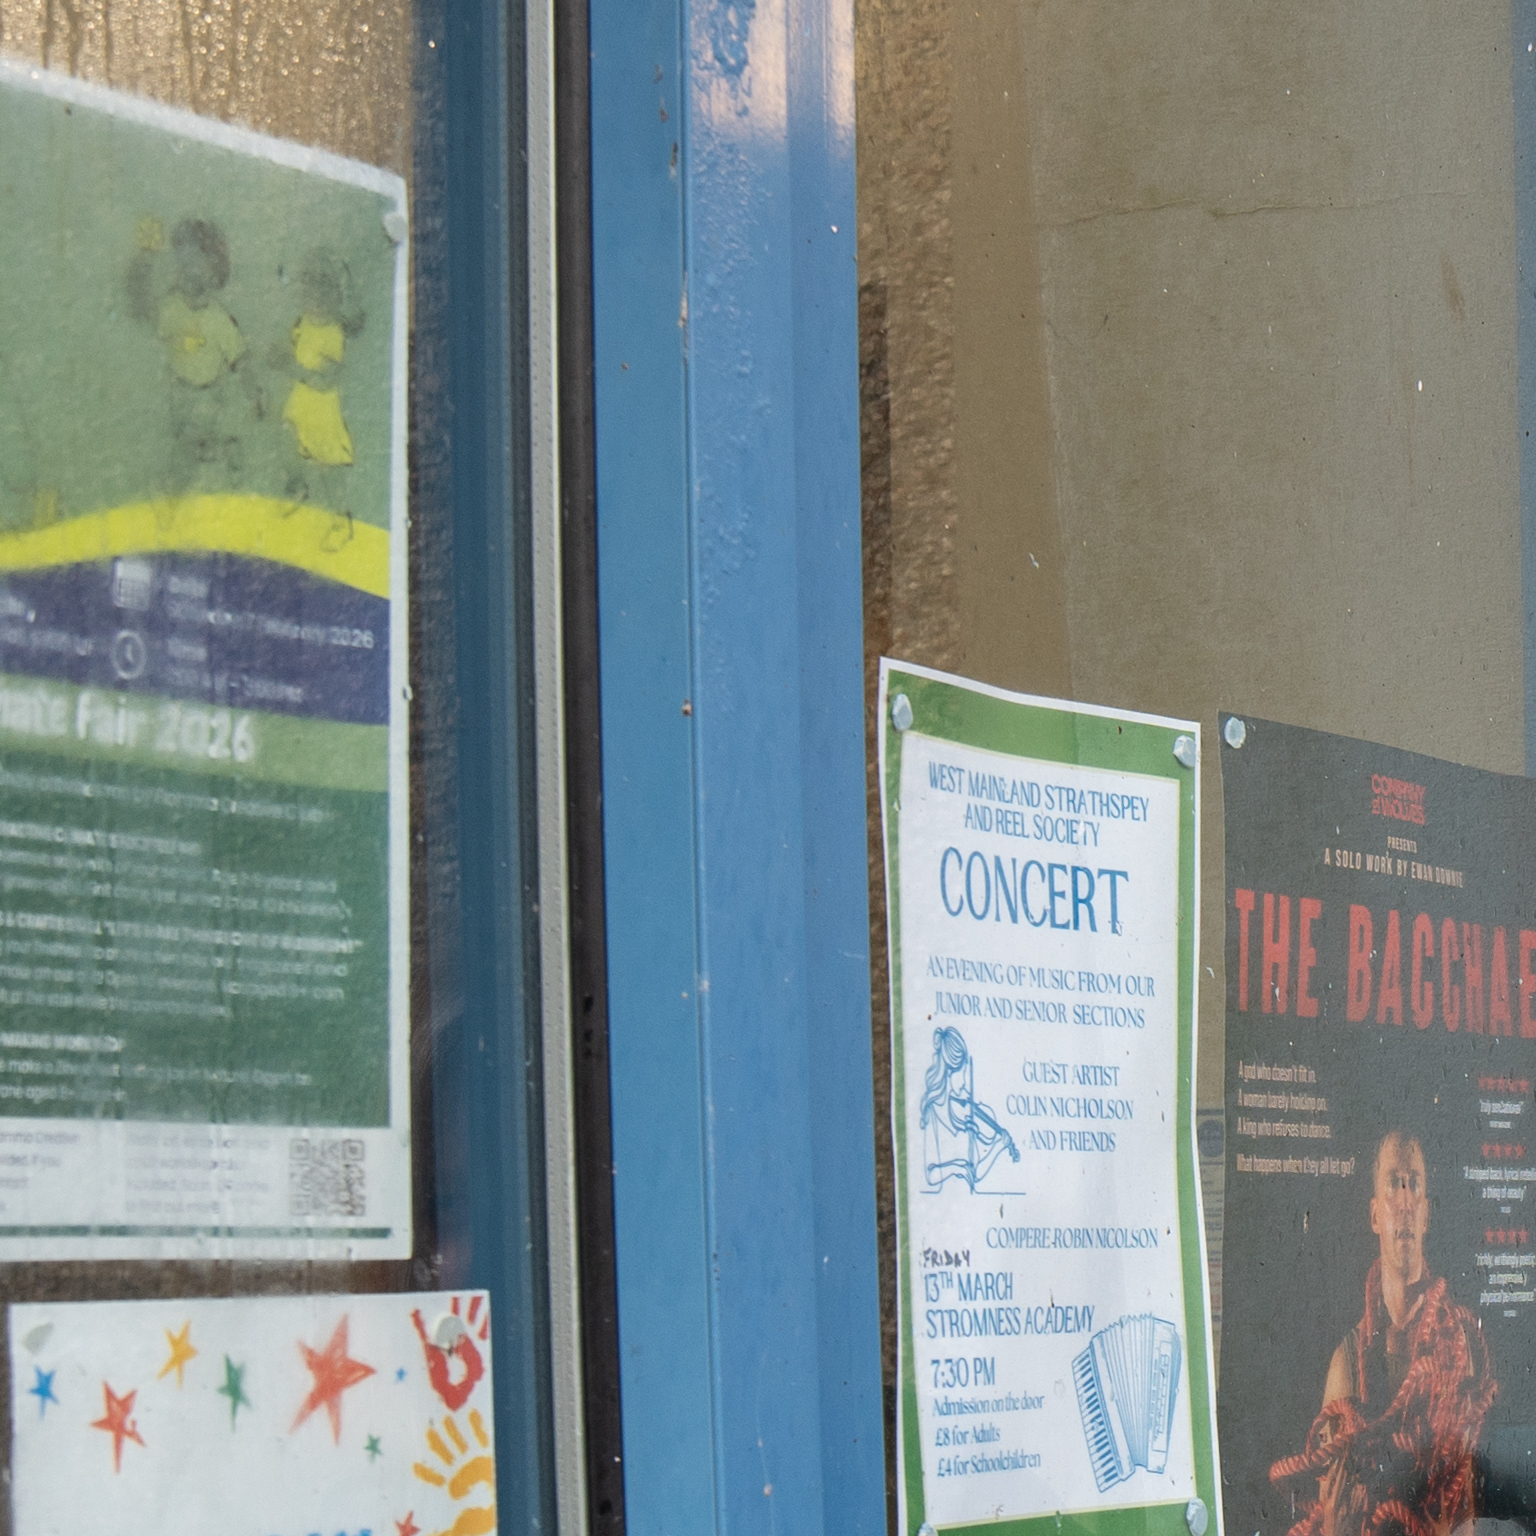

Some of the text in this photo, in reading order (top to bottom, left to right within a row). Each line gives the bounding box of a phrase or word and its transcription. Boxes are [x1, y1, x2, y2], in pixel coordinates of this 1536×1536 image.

[155, 702, 256, 763] 2026
[928, 761, 1149, 822] WEST MAINLAND STRATHSPEY
[964, 802, 1100, 847] AND REEL SOCIETY
[1387, 836, 1417, 853] PRESENTS
[1324, 848, 1330, 865] A
[1335, 850, 1361, 870] SOLO
[1366, 854, 1392, 875] WORK
[1397, 858, 1407, 877] BY
[1411, 861, 1433, 881] EWAN
[940, 847, 1129, 936] CONCERT
[1235, 888, 1321, 1017] THE
[926, 955, 1155, 997] AN EVENING OF MUSIC FROM OUR
[934, 991, 1145, 1029] JUNIOR AND SENIOR SECTIONS
[1023, 1061, 1119, 1086] GUEST ARTIST
[1006, 1094, 1134, 1120] COLIN NICHOLSON
[1029, 1130, 1116, 1152] AND FRIENDS
[1096, 1227, 1158, 1249] NICOLSON
[922, 1249, 970, 1268] FRIDAY
[924, 1271, 1013, 1302] 13TH MARCH
[926, 1305, 1095, 1338] STROMNESS ACADEMY
[931, 1357, 995, 1388] 7:30 PM
[935, 1422, 1000, 1447] £8 for Adults
